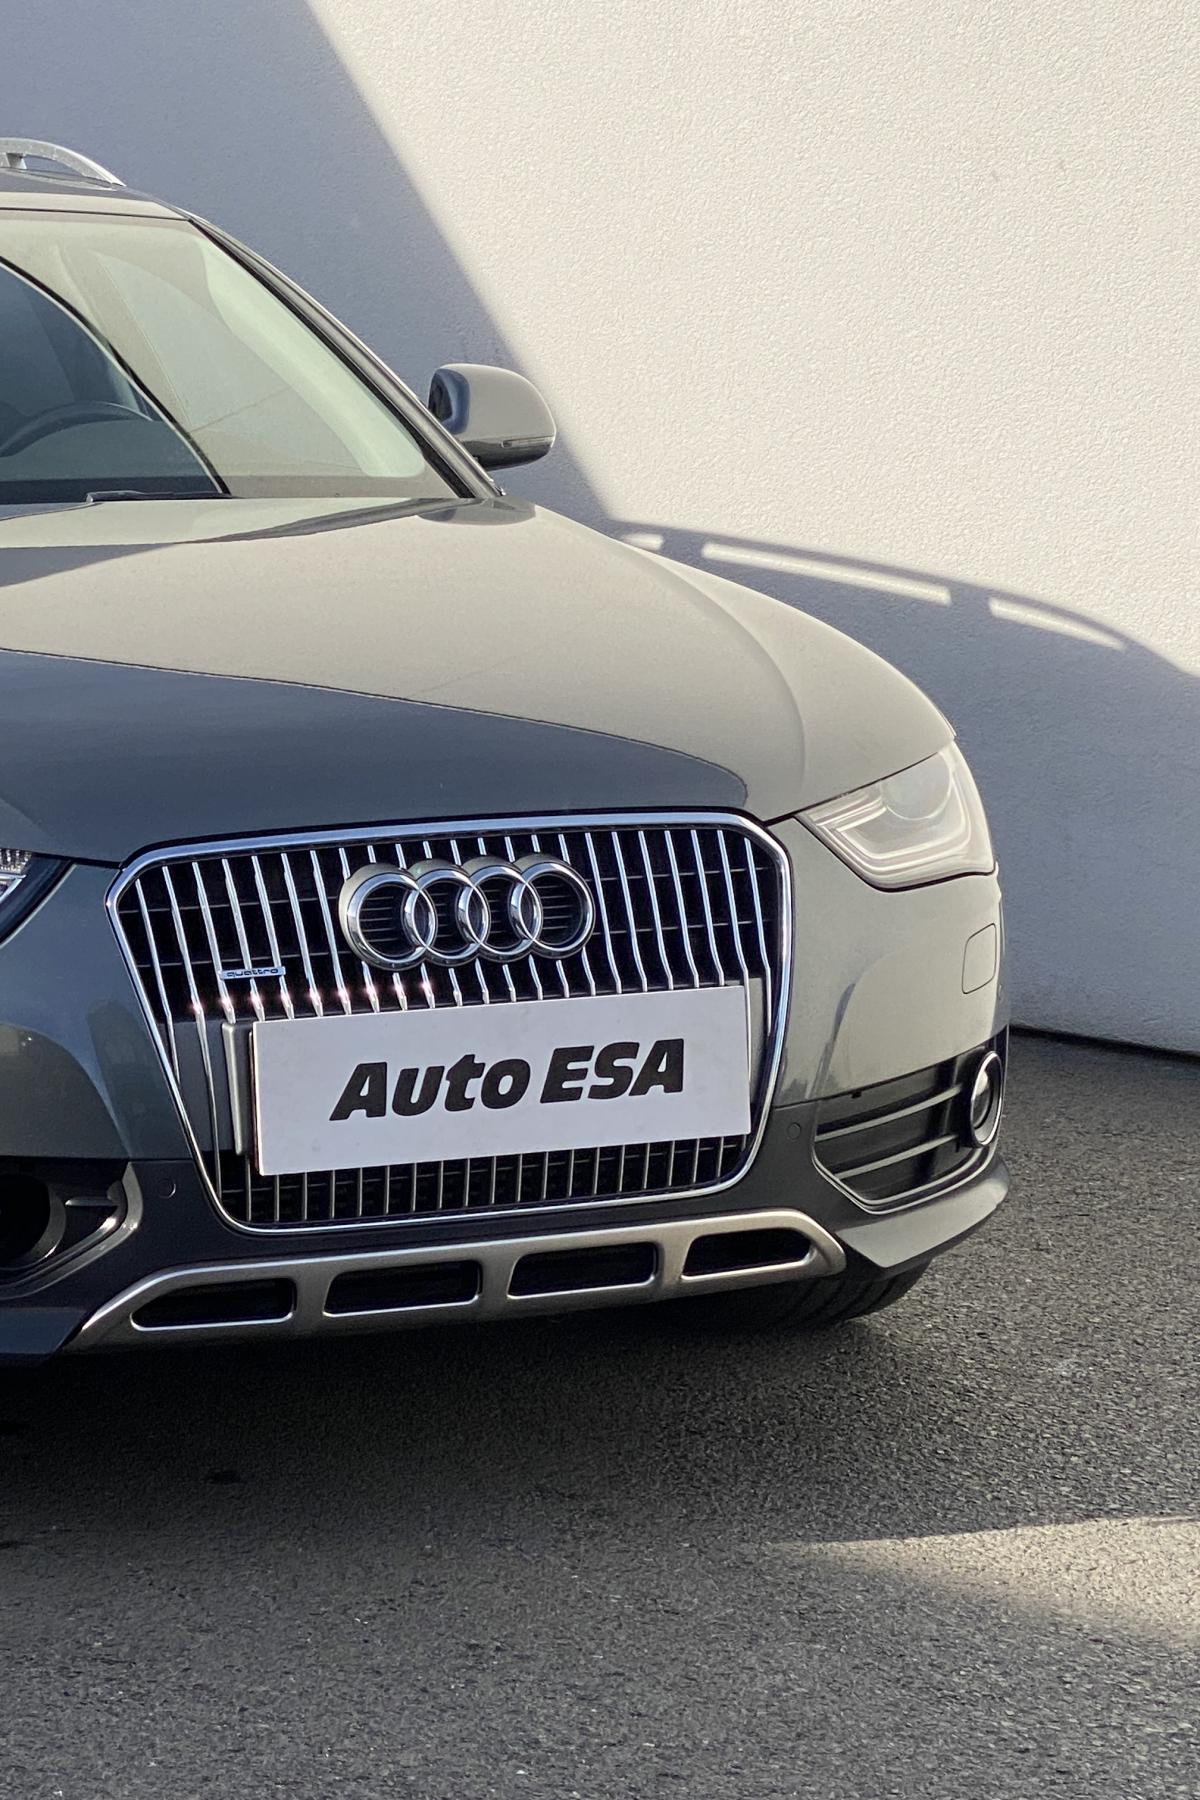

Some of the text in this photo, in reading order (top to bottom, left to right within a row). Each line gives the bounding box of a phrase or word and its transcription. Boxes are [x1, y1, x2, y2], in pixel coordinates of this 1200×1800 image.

[226, 968, 279, 978] quattro
[329, 1038, 685, 1122] Auto ESA
